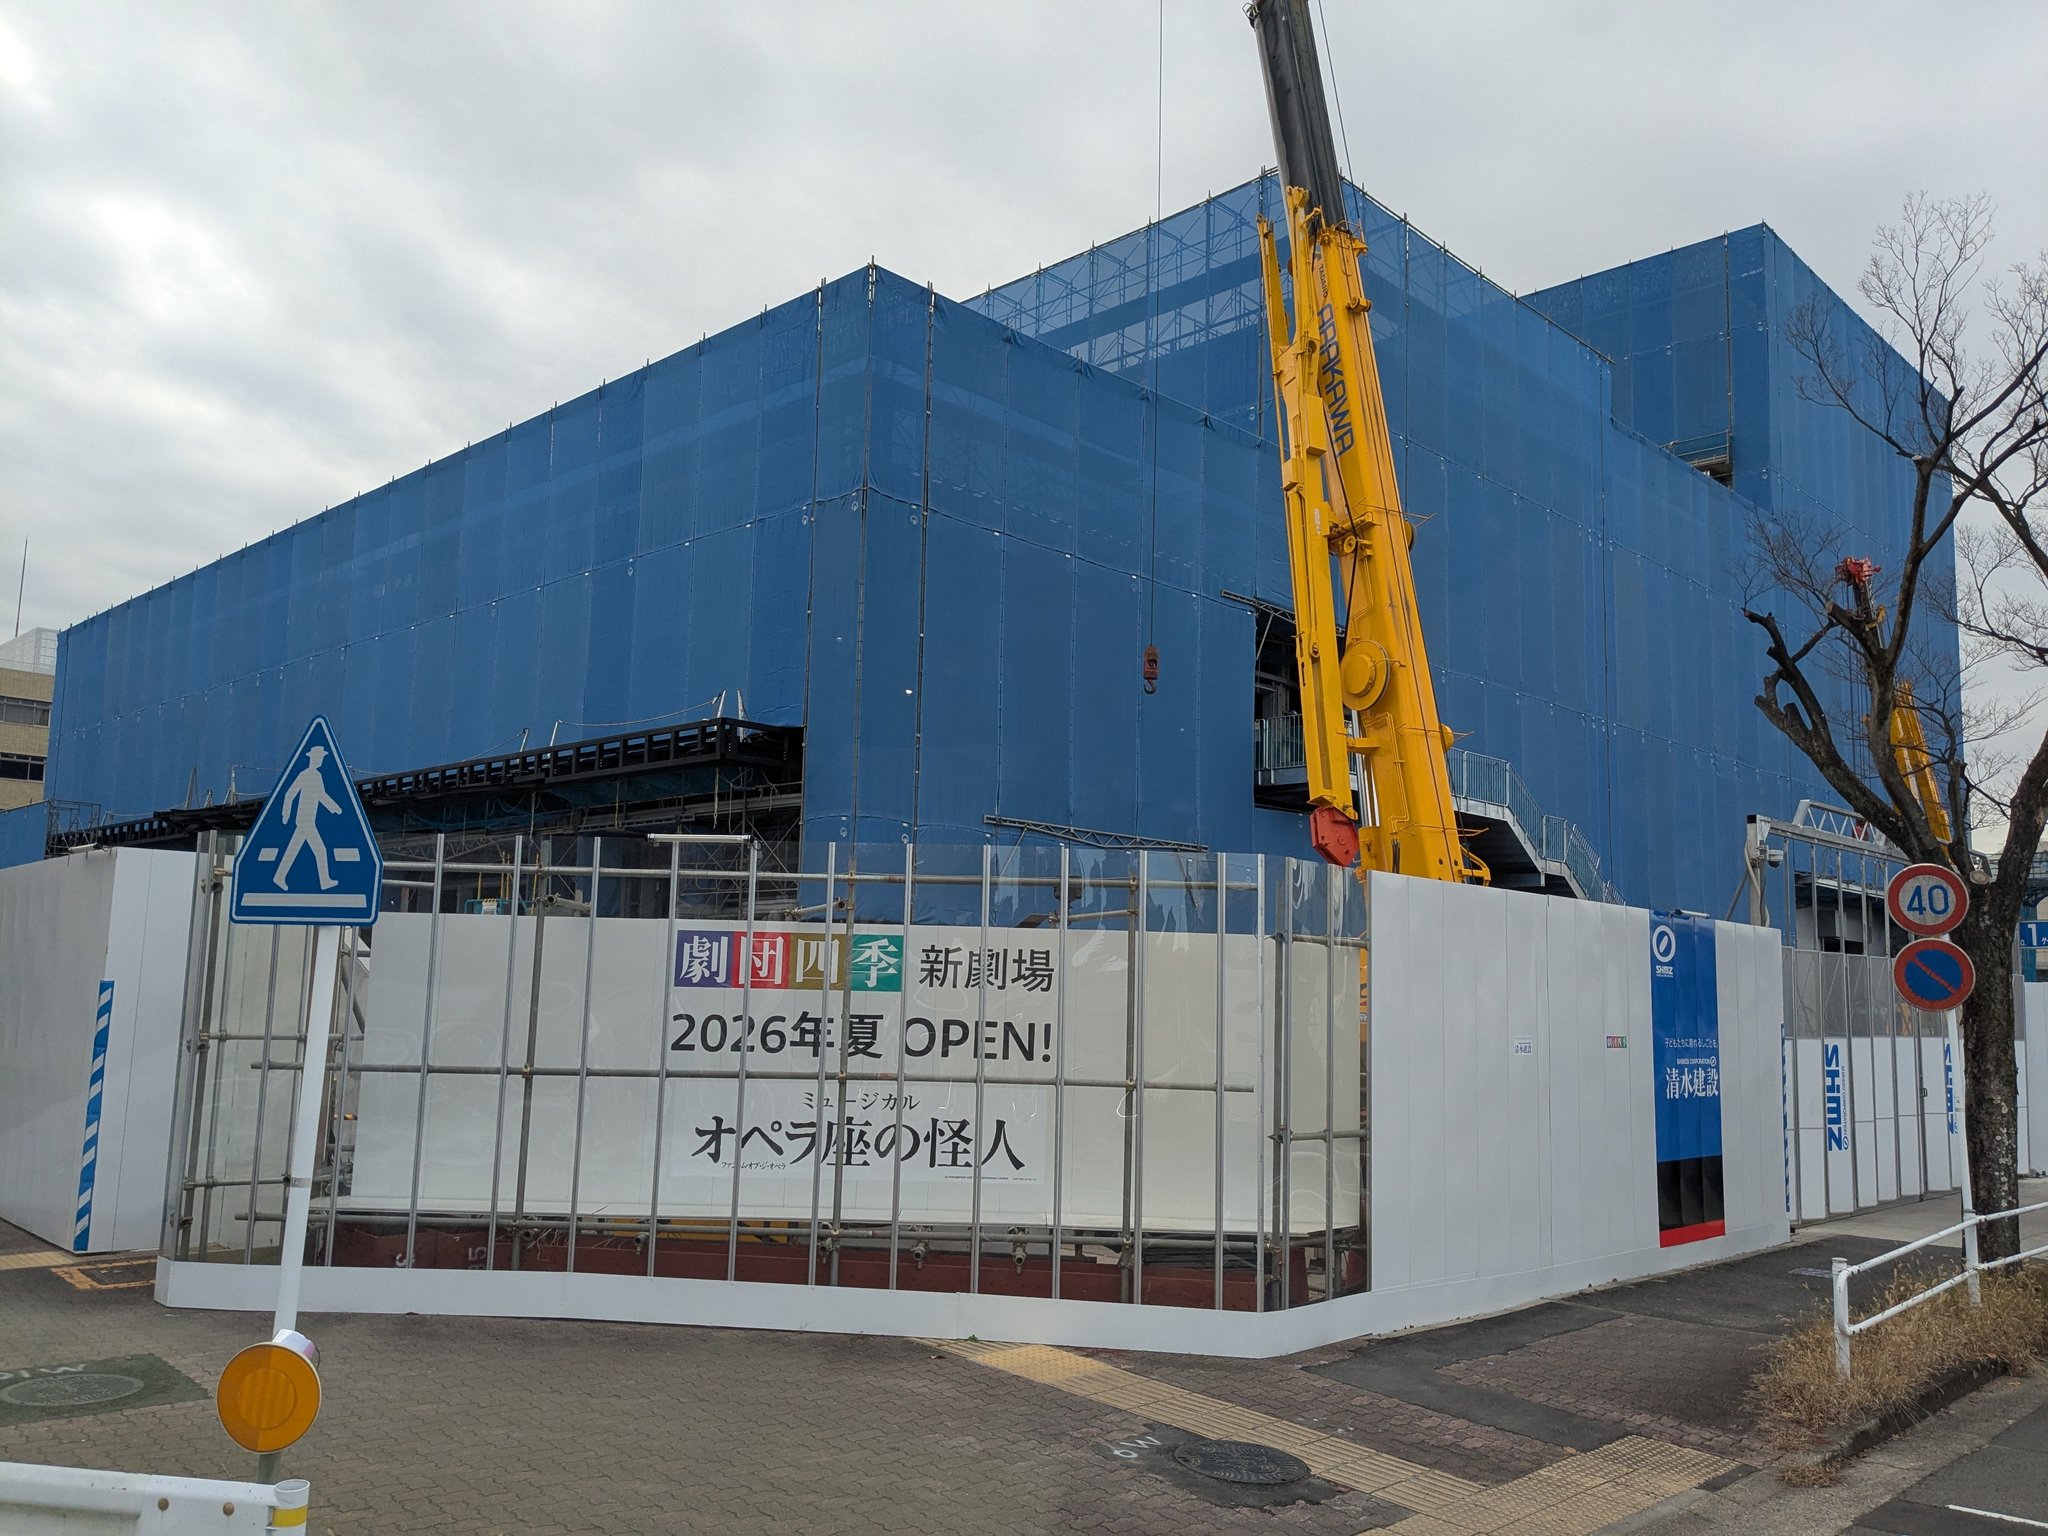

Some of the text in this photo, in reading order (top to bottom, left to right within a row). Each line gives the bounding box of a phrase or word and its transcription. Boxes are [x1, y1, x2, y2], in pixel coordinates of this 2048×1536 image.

[1317, 303, 1354, 457] ARAKAWA
[1907, 885, 1949, 915] 40
[680, 935, 1054, 992] 劇団四季 新劇場
[671, 1011, 1051, 1063] 2026年夏 OPEN!
[803, 1091, 920, 1111] ミュージカル
[1666, 1067, 1719, 1099] 清水建設
[691, 1116, 1025, 1171] オペラ座の怪人
